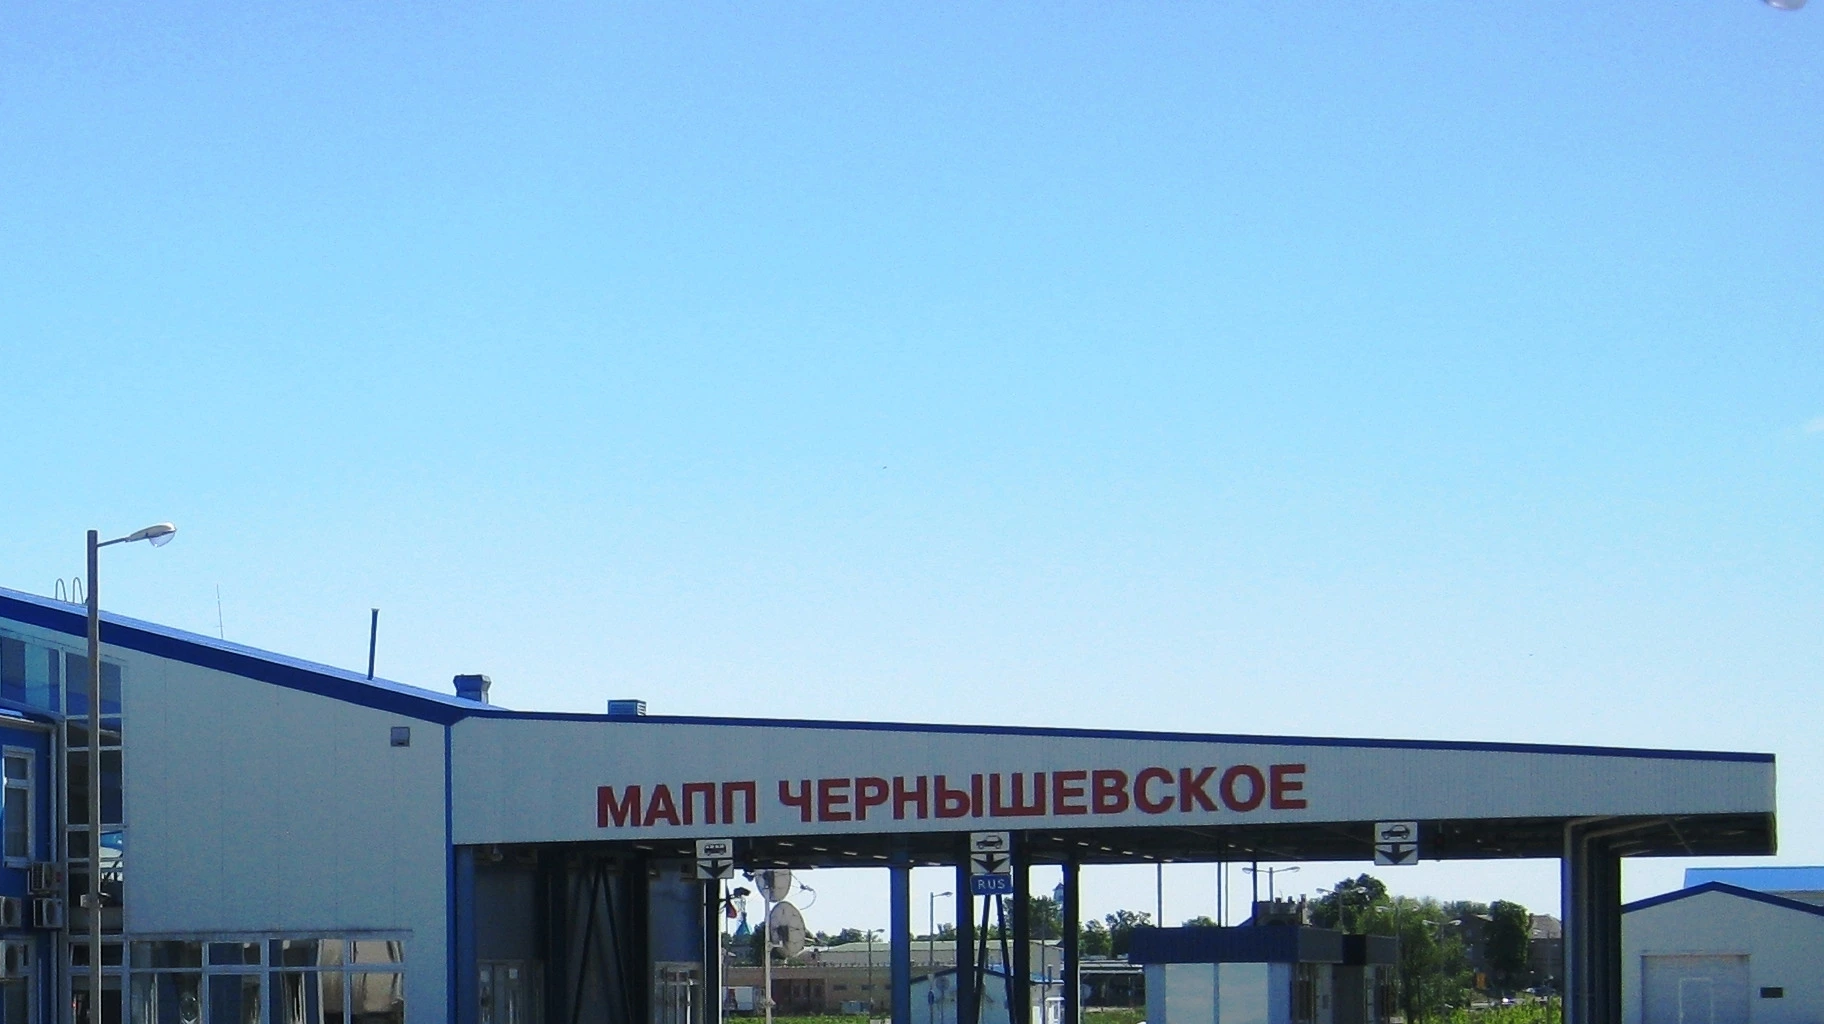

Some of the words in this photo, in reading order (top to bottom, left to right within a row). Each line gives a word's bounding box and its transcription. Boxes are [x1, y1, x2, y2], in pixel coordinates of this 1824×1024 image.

[596, 780, 757, 828] МАПП
[778, 763, 1307, 823] ЧЕРНЫШЕВСКОЕ
[977, 879, 1006, 890] RUS
